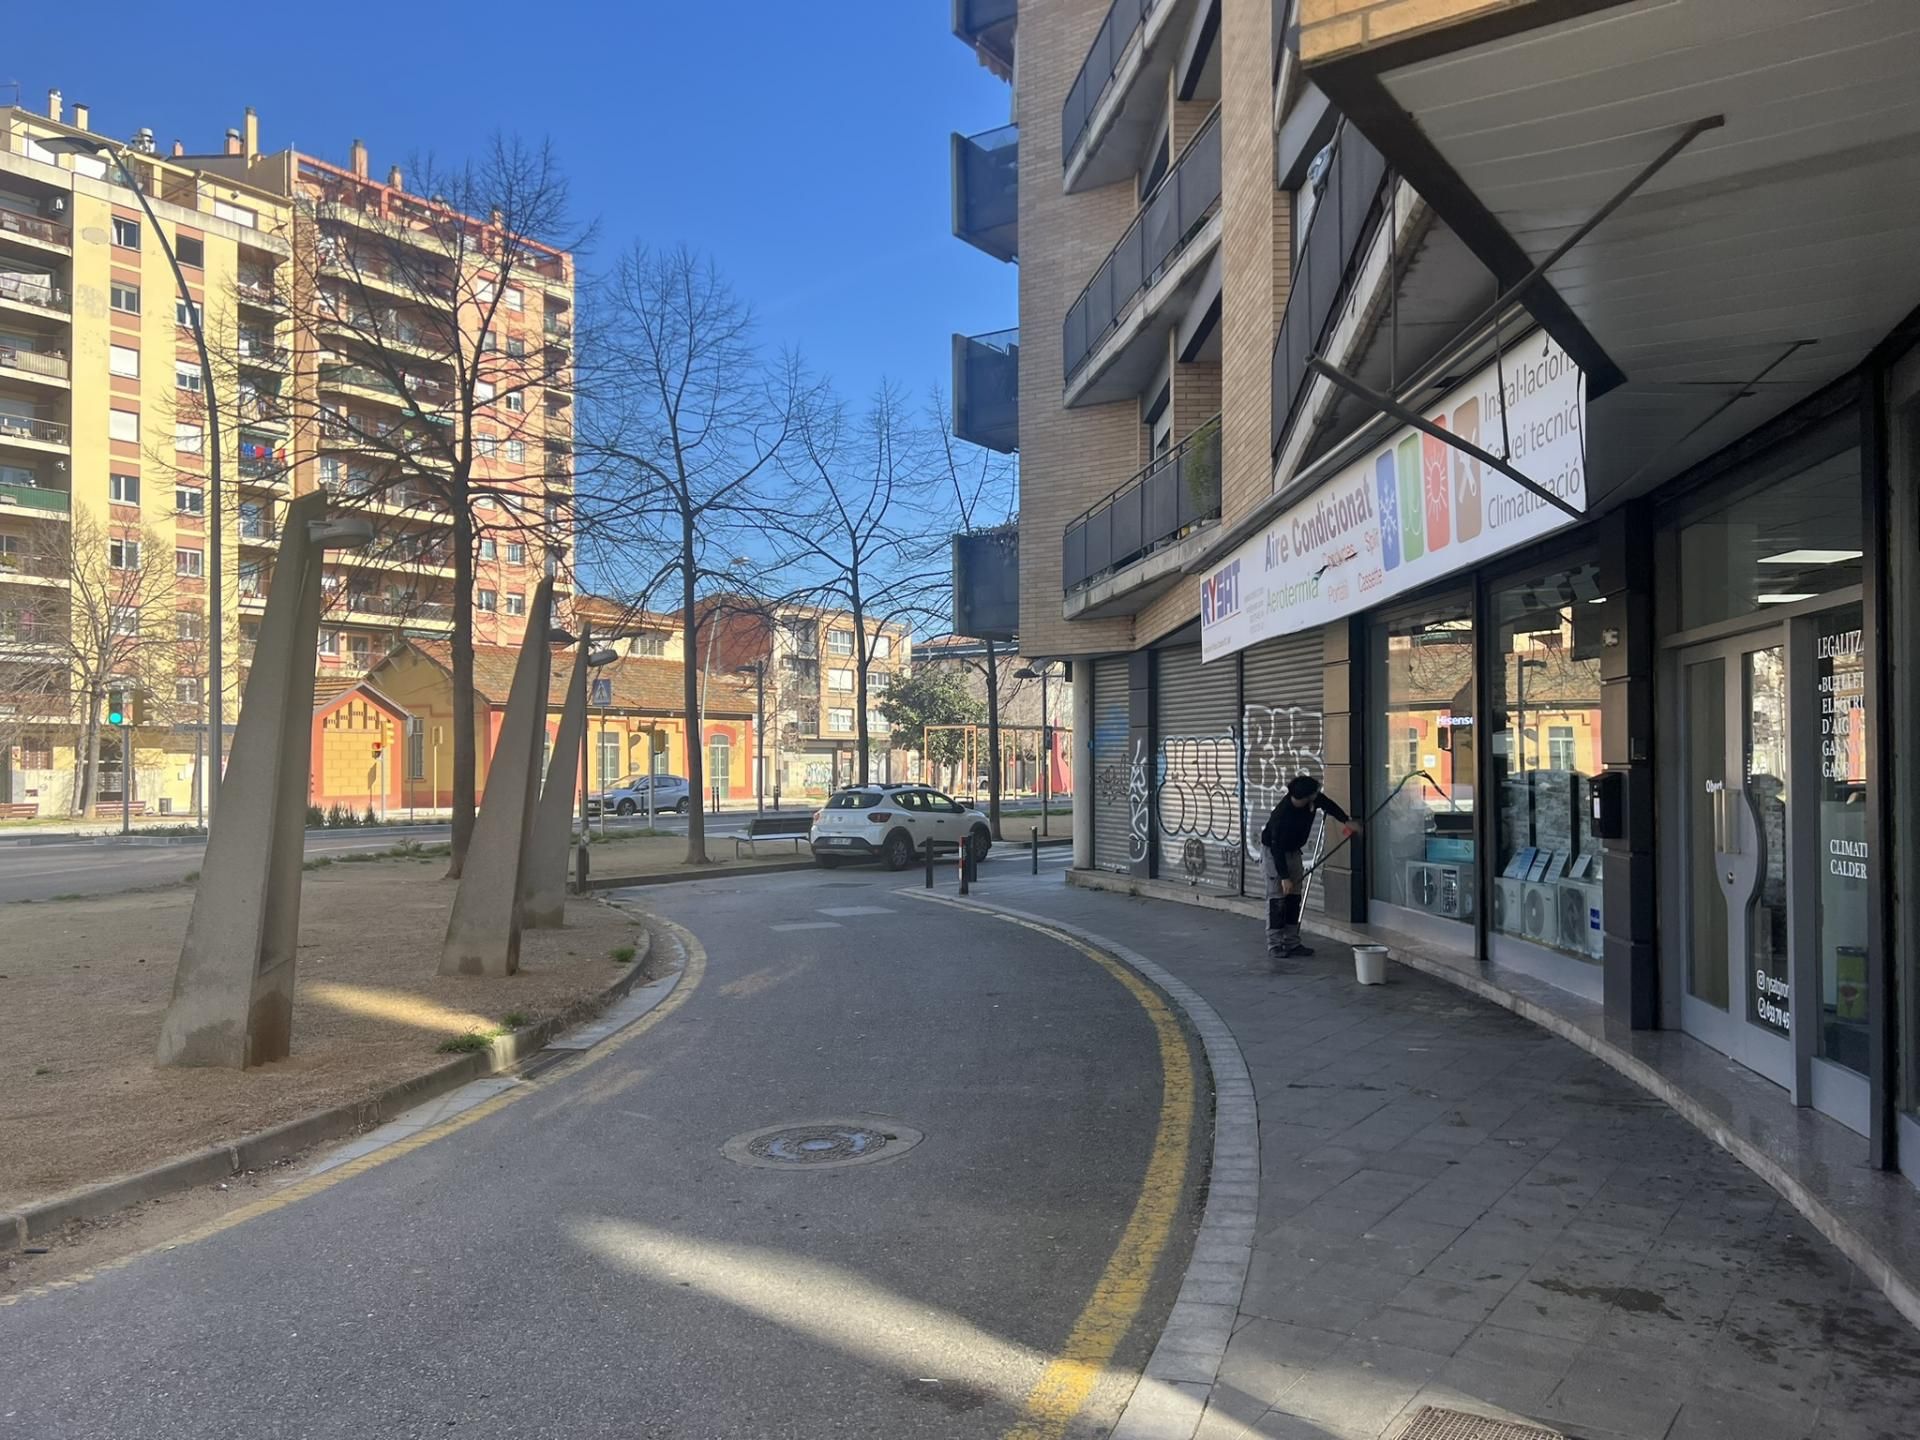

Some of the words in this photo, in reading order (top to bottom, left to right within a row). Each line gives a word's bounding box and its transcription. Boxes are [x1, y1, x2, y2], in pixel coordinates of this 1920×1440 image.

[1530, 401, 1578, 452] tecnic
[1265, 531, 1289, 573] Aire
[1292, 472, 1373, 558] Condicionat
[1266, 571, 1320, 616] Aerotermia
[1818, 630, 1864, 659] LEGALITZ
[1830, 839, 1868, 858] CLIMATI
[1830, 859, 1868, 880] CALDER
